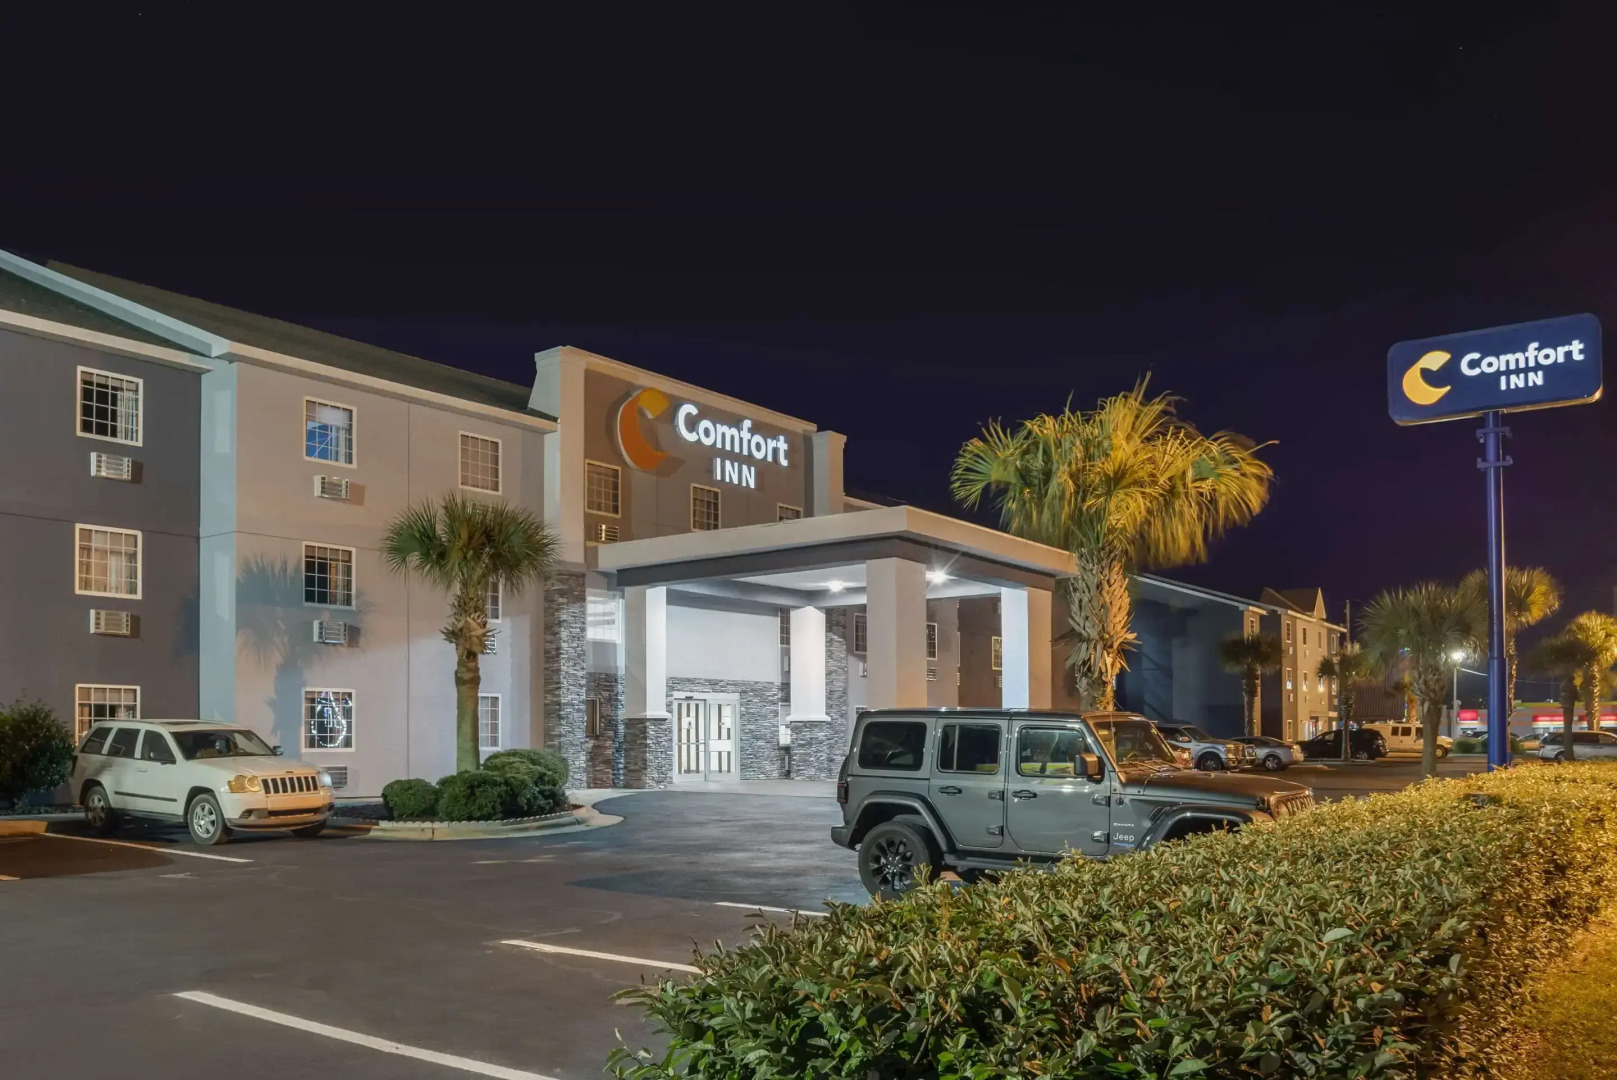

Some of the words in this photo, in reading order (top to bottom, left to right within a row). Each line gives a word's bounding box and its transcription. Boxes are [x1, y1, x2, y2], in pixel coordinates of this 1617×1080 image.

[1460, 339, 1585, 376] Comfort
[1500, 370, 1544, 391] INN
[677, 403, 789, 467] Comfort
[714, 457, 756, 489] INN
[1113, 832, 1135, 843] Jeep
